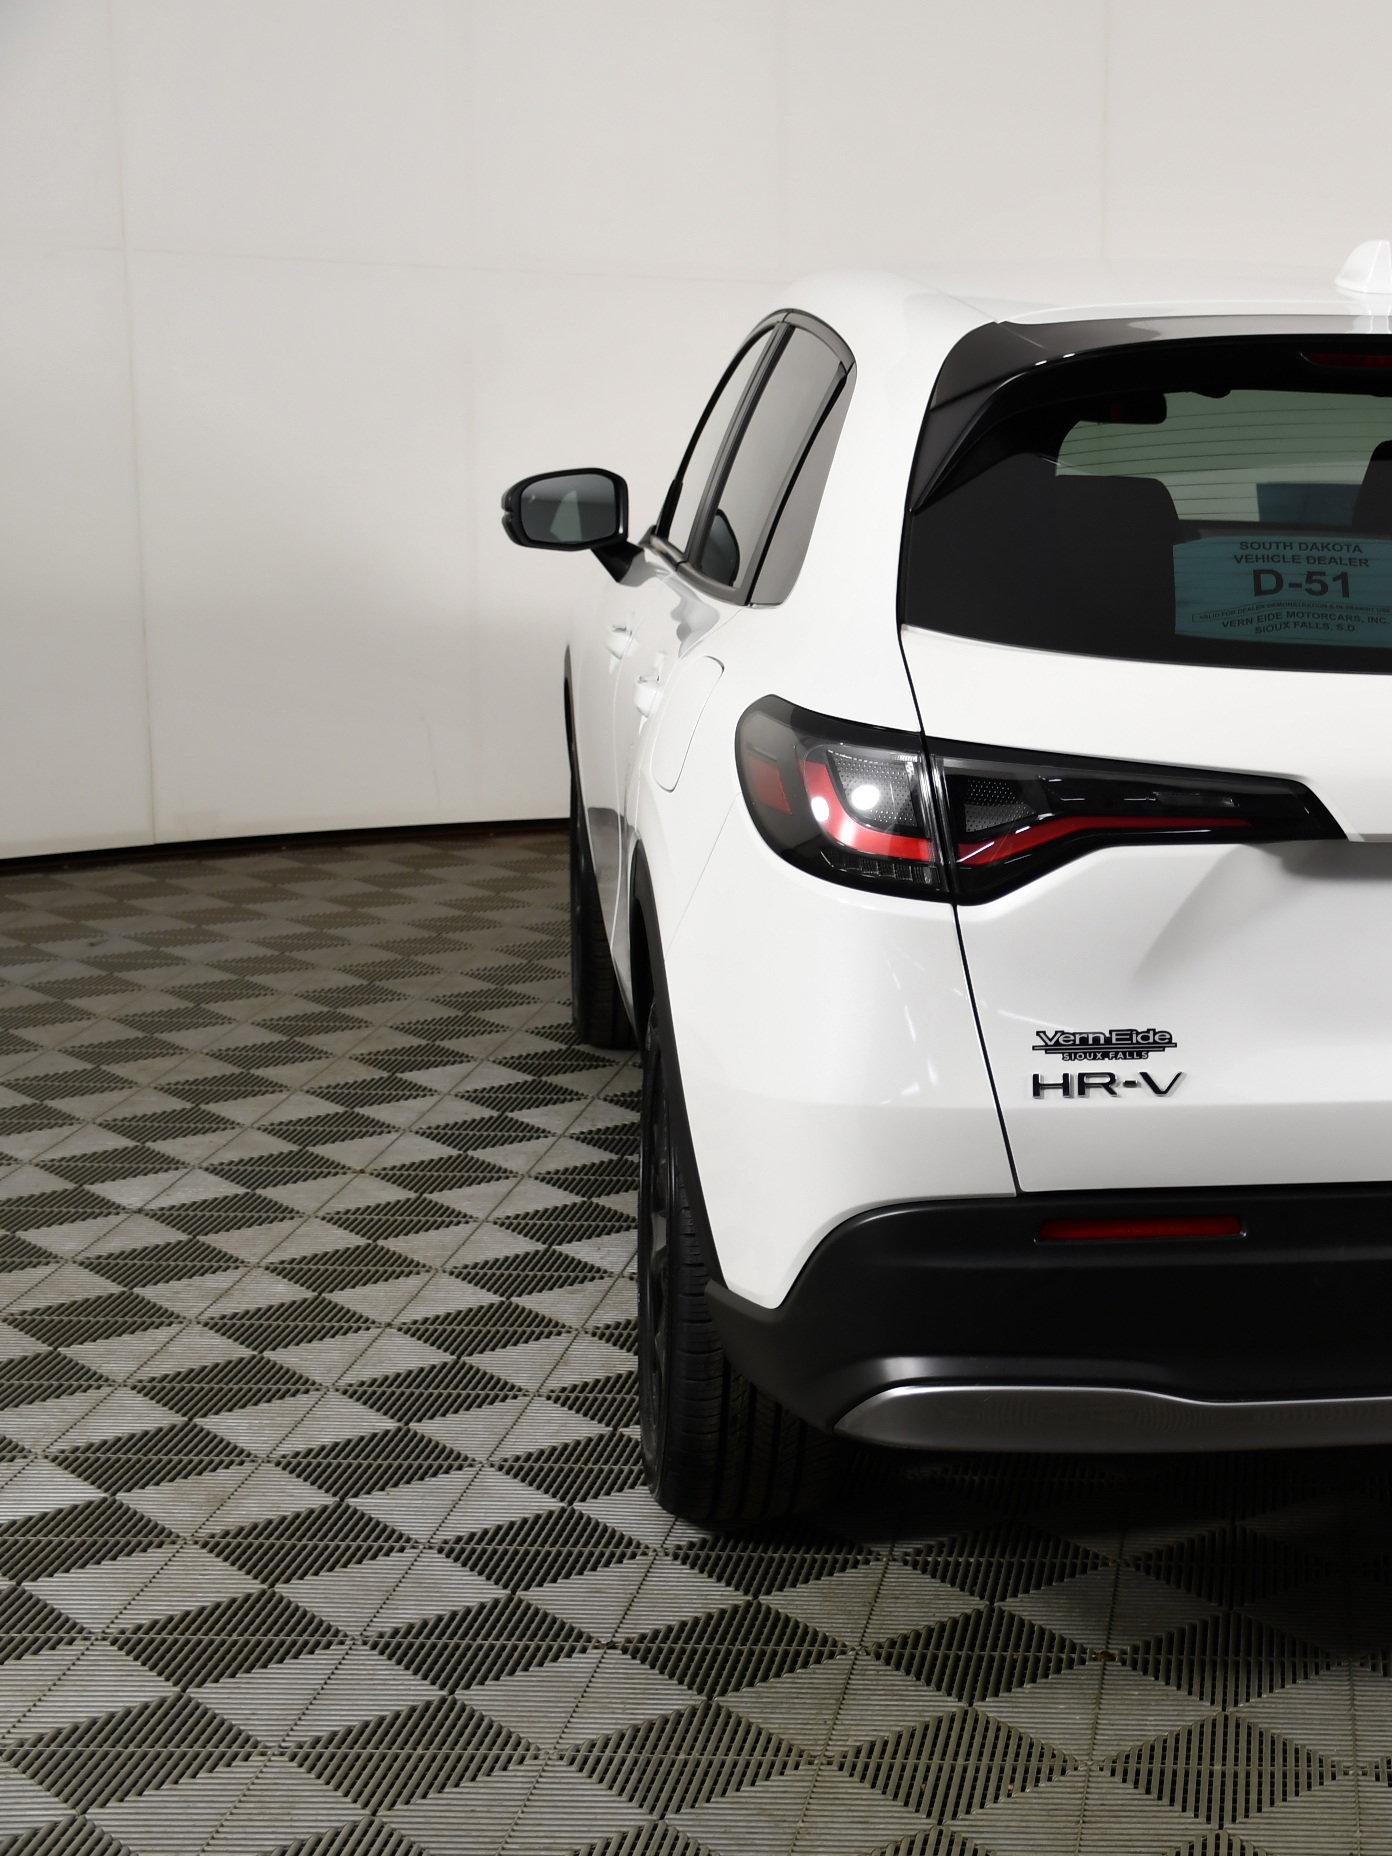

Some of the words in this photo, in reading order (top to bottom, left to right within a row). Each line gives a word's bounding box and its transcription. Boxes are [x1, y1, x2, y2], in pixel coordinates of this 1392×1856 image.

[1239, 541, 1293, 551] SOUTH
[1298, 542, 1363, 553] DAKOTA
[1233, 554, 1302, 564] VEHICLE
[1306, 555, 1369, 567] DEALER
[1252, 569, 1350, 598] D-51
[1222, 617, 1253, 628] VERN
[1256, 612, 1282, 623] EIDE
[1286, 611, 1364, 623] MOTORCARS,
[1367, 616, 1390, 624] INC.
[1255, 622, 1290, 634] SIOUX
[1293, 621, 1333, 631] FALLS,
[1038, 1031, 1105, 1046] Vern
[1111, 1029, 1172, 1044] Eide
[1063, 1052, 1103, 1060] SIOUX
[1109, 1051, 1148, 1060] FALLS
[1032, 1072, 1183, 1099] HR-V
